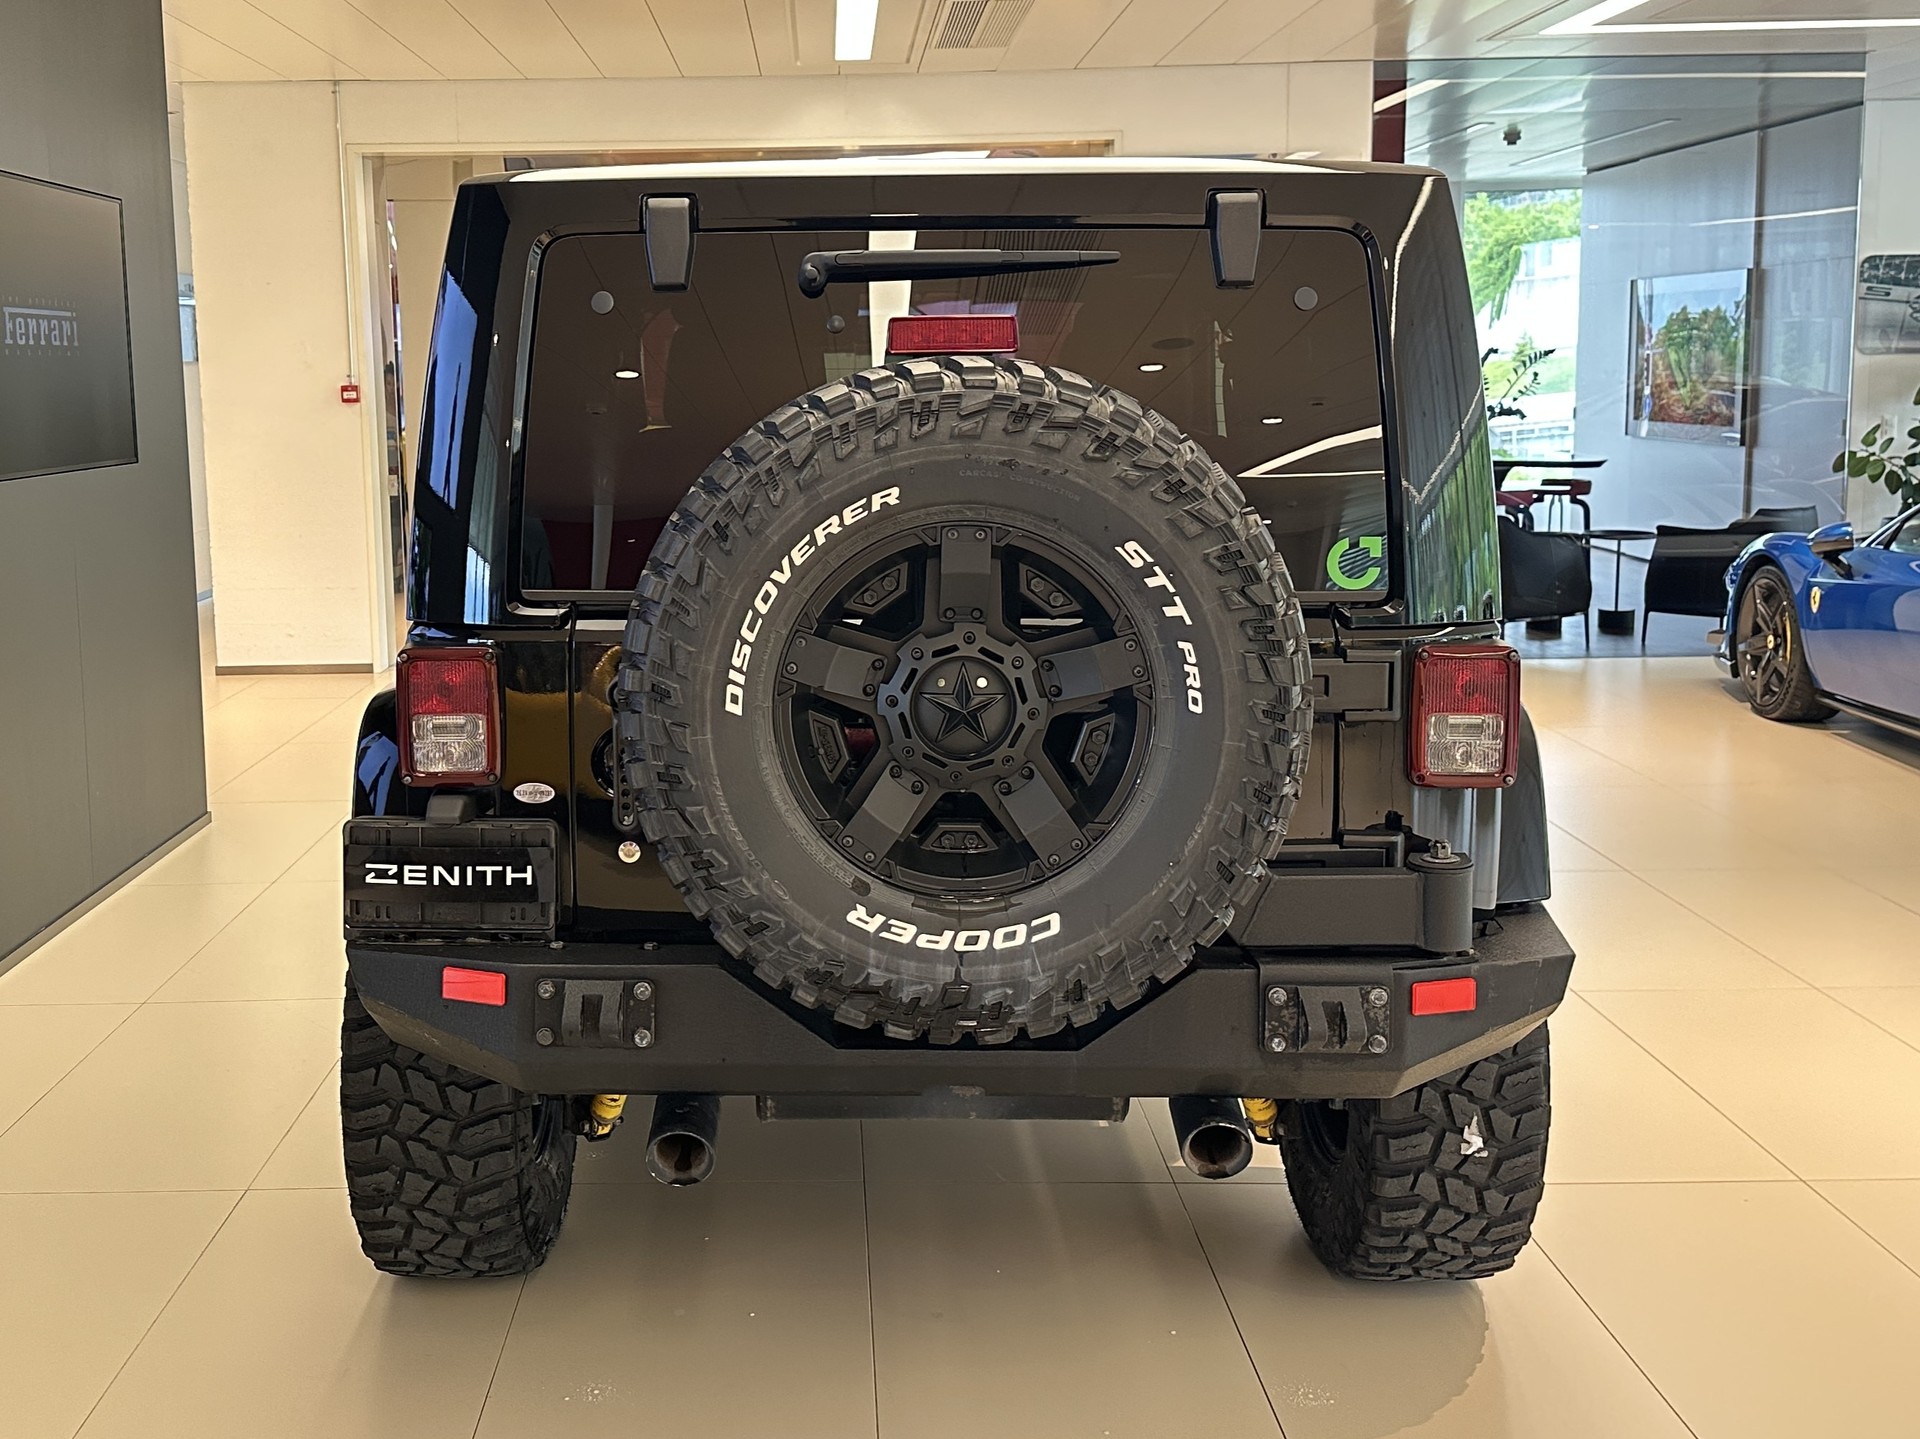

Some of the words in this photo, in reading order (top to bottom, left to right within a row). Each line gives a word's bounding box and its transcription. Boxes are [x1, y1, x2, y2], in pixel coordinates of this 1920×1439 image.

[3, 306, 79, 347] Ferrari
[725, 486, 901, 717] DISCOVERER
[1114, 540, 1193, 626] STT
[1176, 640, 1204, 715] PRO
[365, 863, 533, 886] ZENITH
[845, 903, 1061, 952] COOPER
